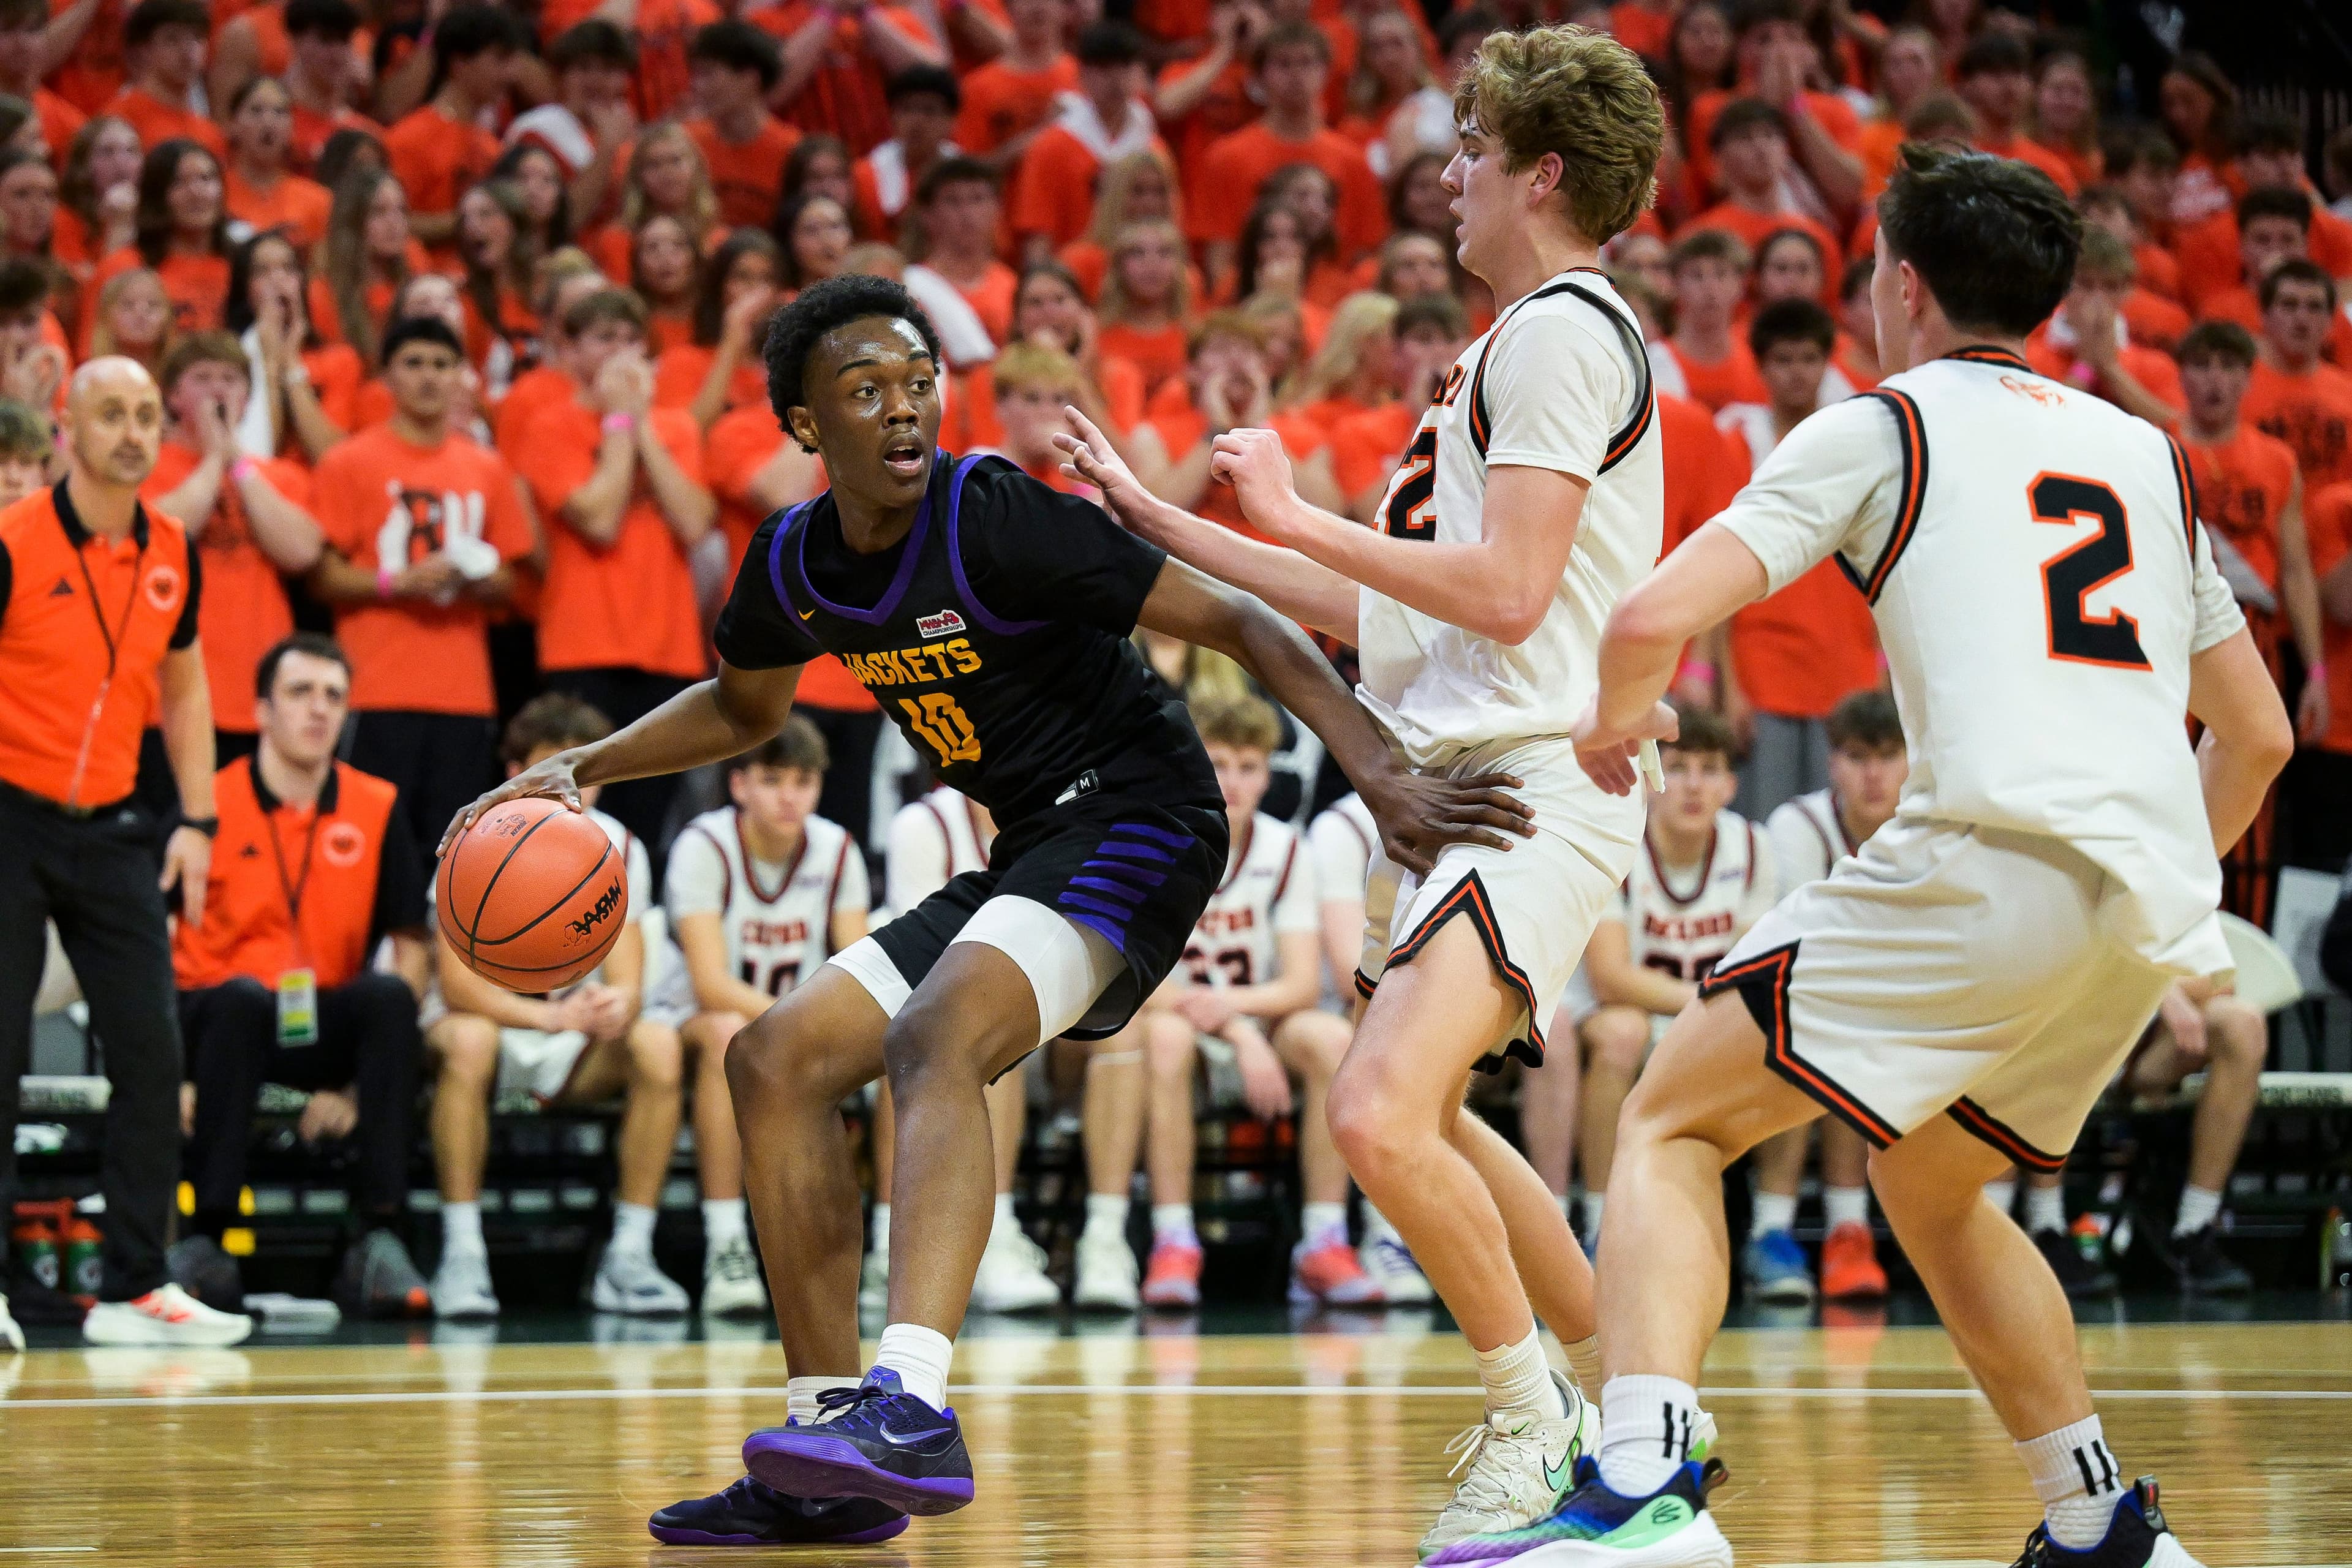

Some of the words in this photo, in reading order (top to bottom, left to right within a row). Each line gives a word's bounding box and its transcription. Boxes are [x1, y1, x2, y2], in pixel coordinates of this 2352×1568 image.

[2026, 470, 2154, 672] 2
[922, 623, 963, 636] CHAMPIONSHIPS
[843, 638, 982, 685] JACKETS
[897, 692, 981, 767] 10
[1080, 777, 1091, 790] M
